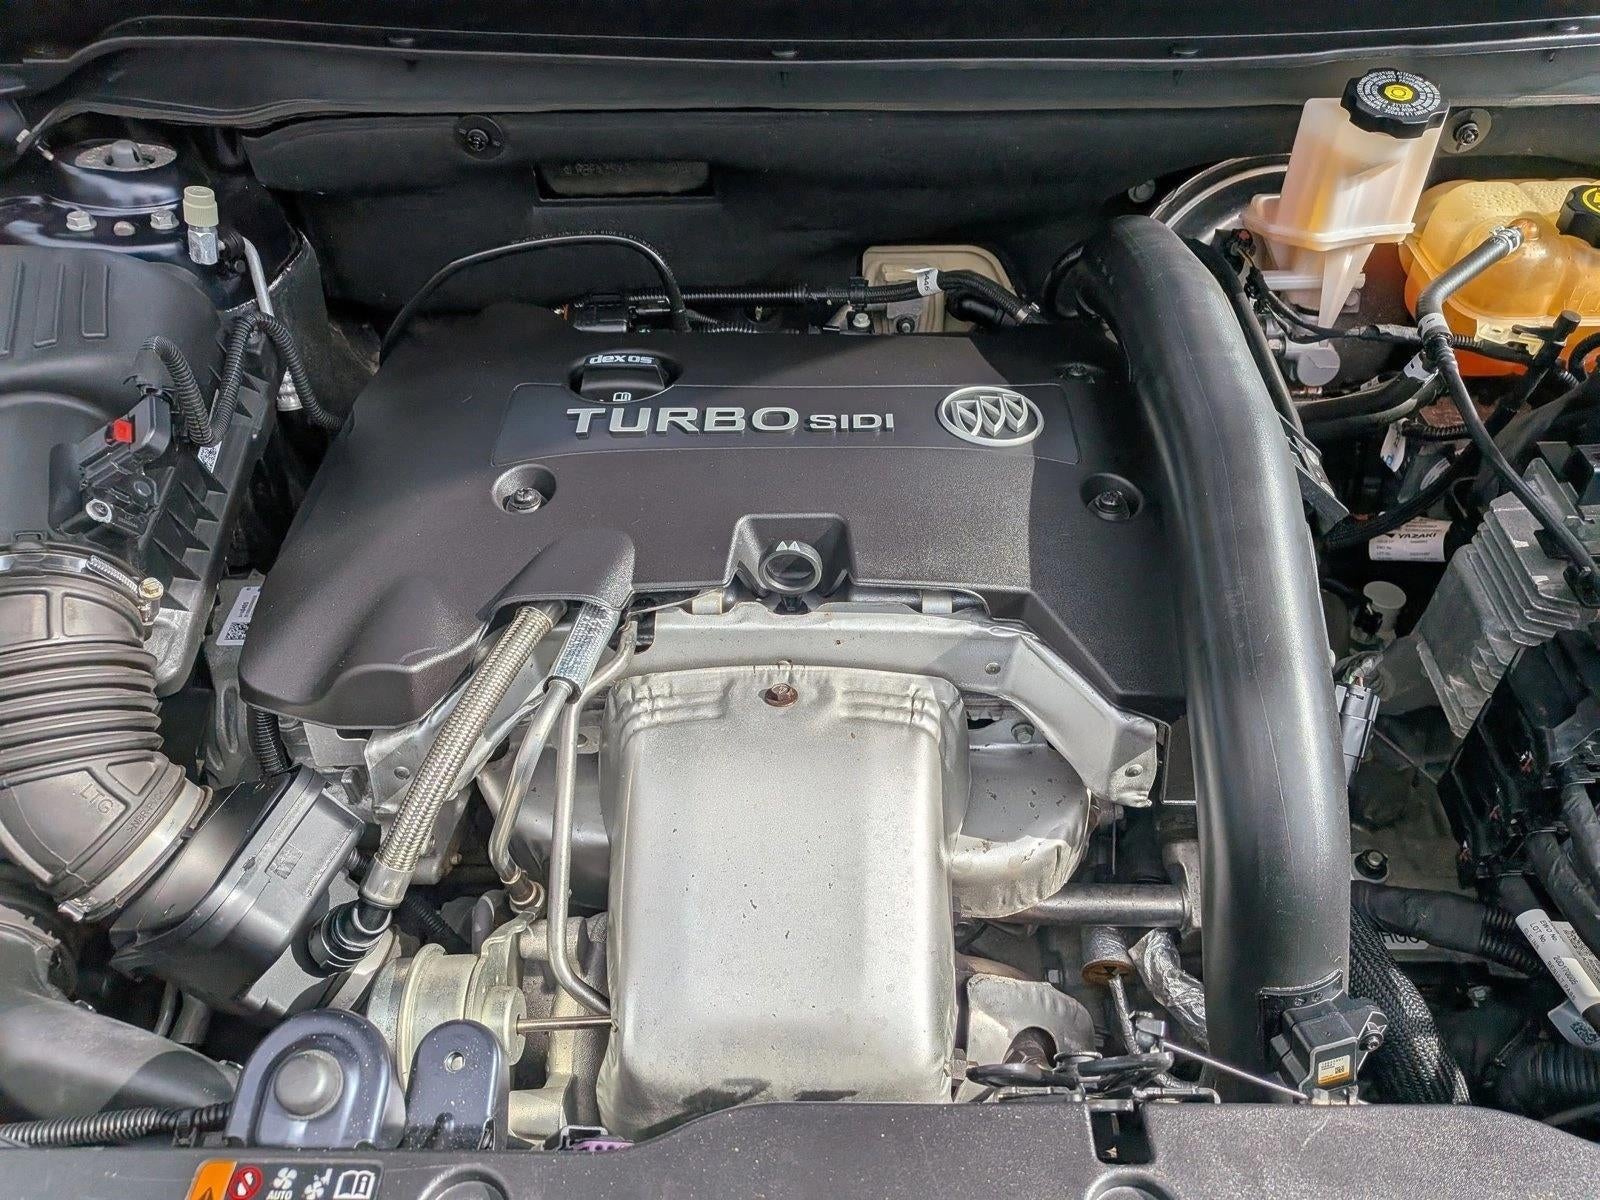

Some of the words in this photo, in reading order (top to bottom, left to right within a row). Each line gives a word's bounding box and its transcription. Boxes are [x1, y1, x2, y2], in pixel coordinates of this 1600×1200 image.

[566, 406, 800, 436] TURBO
[809, 412, 895, 431] SIDI
[80, 783, 114, 814] LTG
[1530, 922, 1542, 936] LOT
[266, 1190, 293, 1200] AUTO
